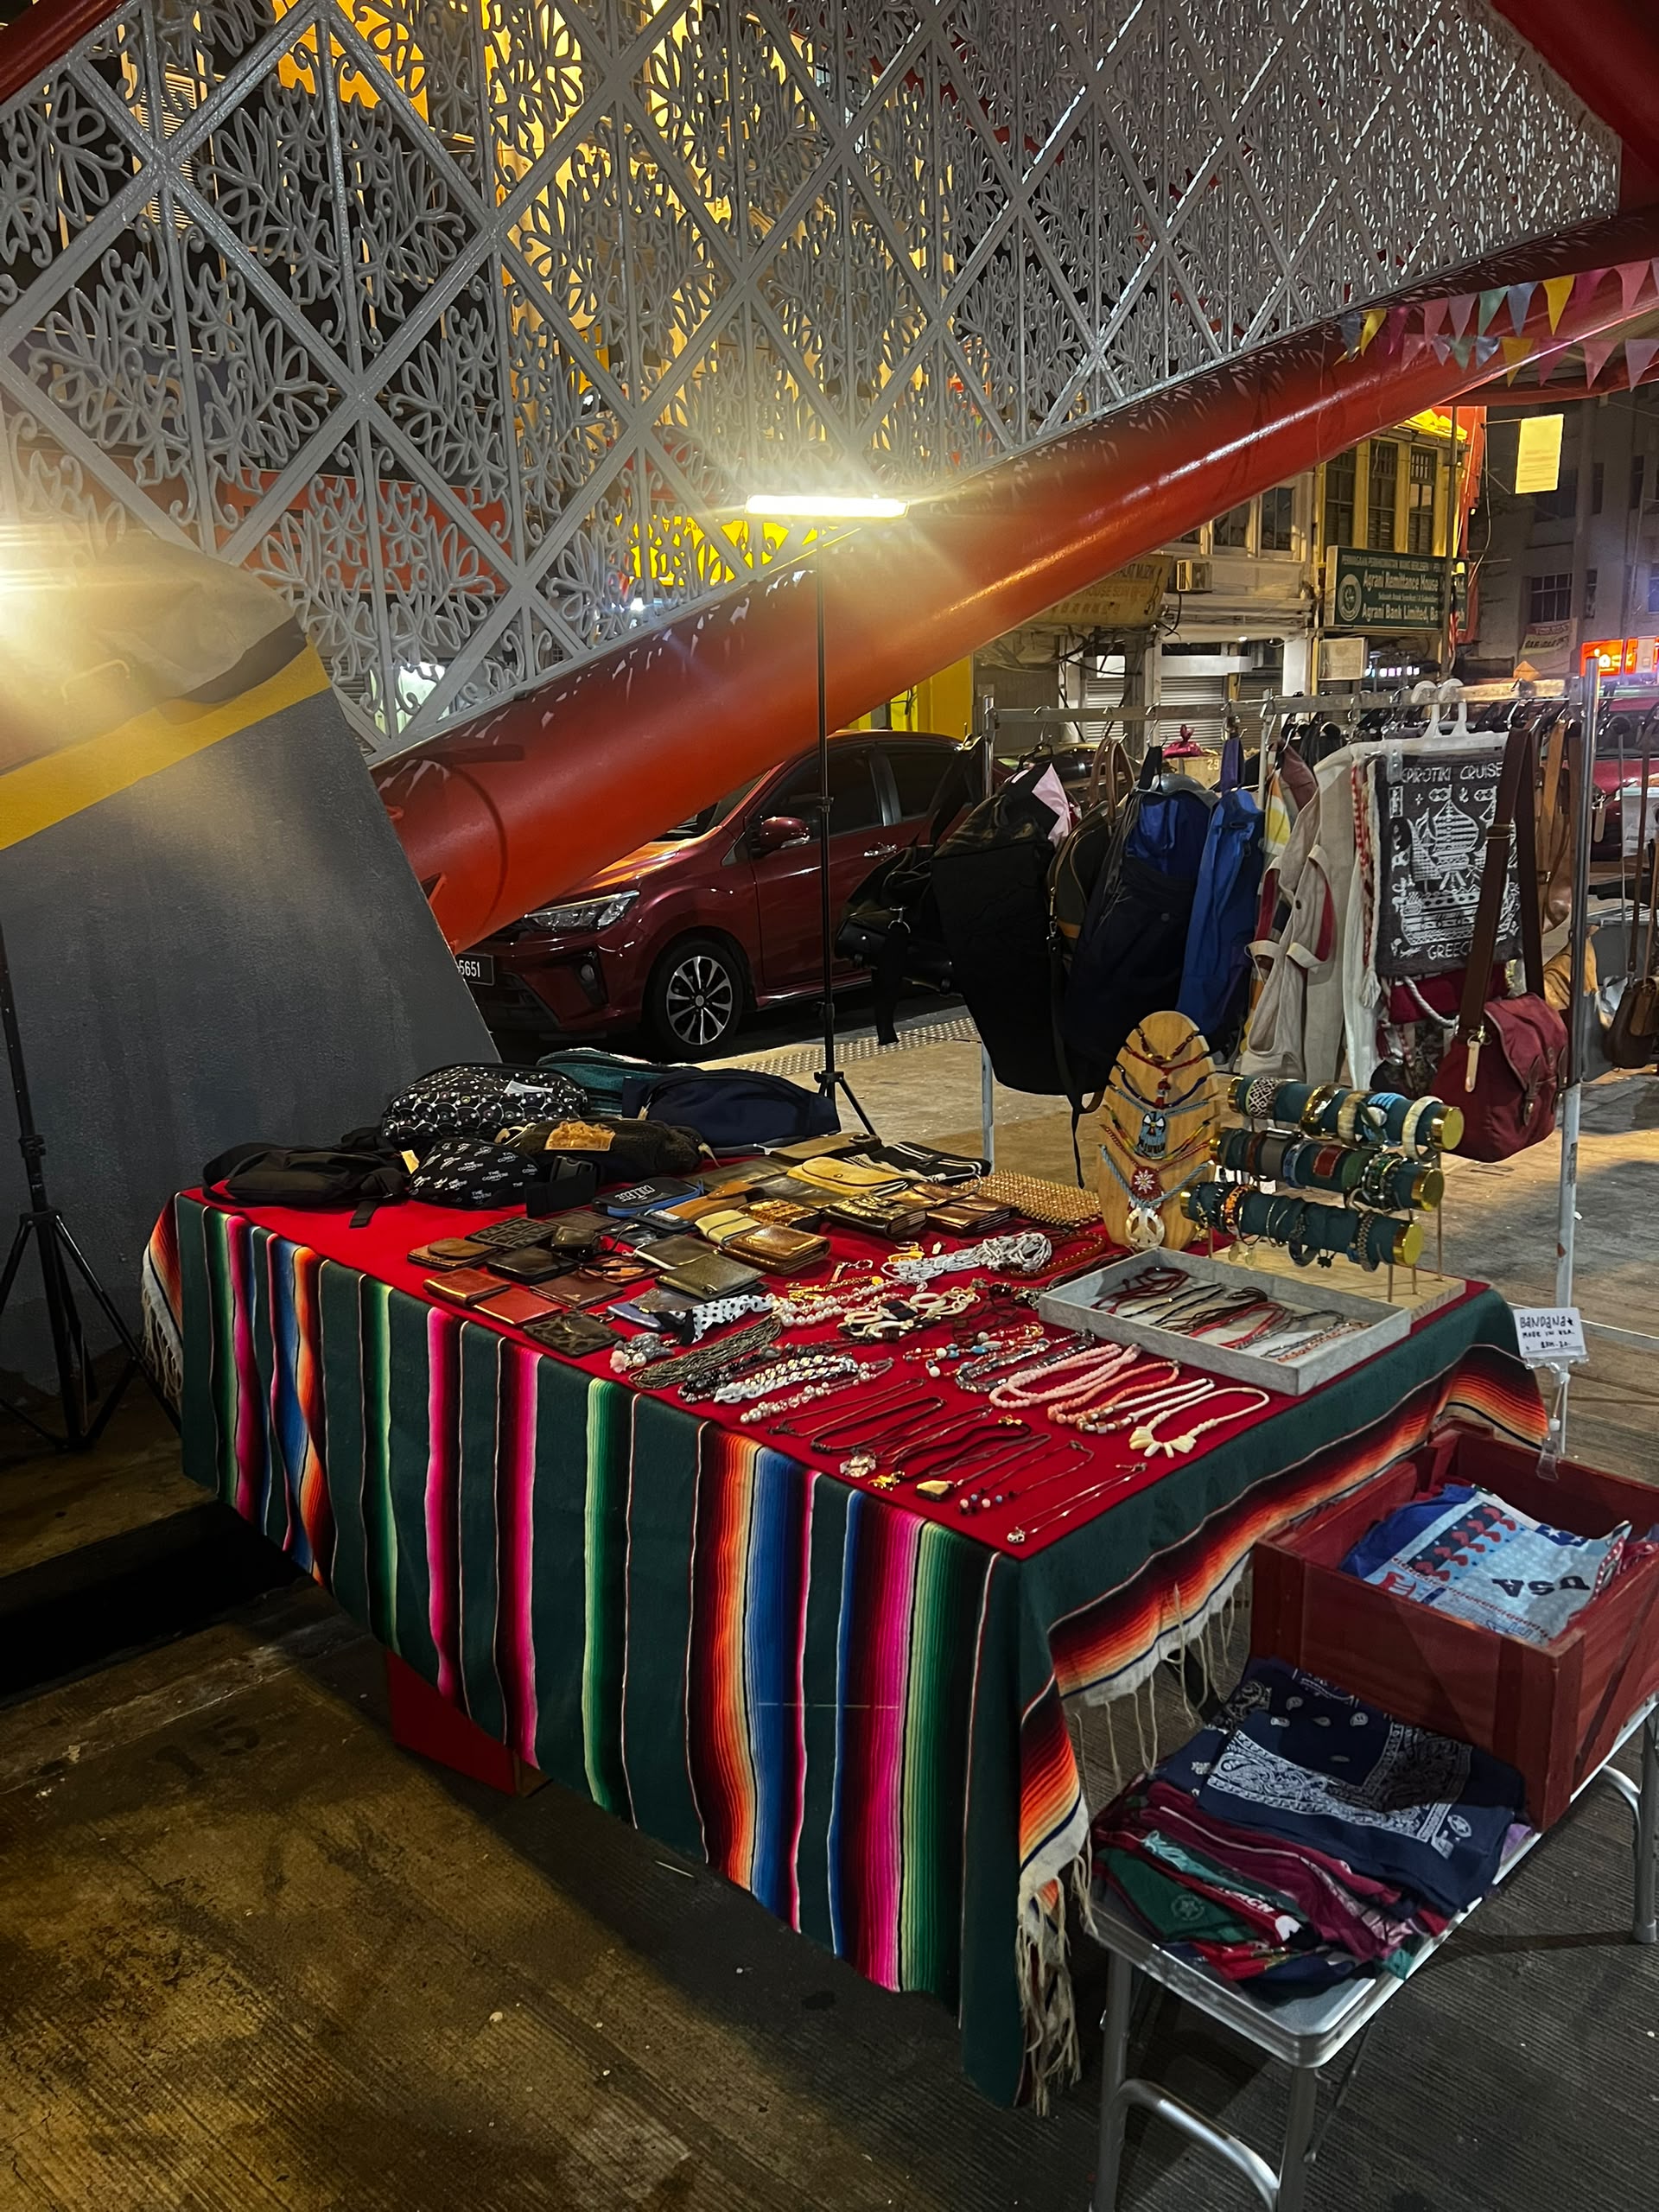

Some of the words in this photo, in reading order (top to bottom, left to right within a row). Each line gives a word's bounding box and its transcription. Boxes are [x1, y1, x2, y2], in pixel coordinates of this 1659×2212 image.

[1363, 569, 1384, 591] Agrani
[1385, 571, 1419, 589] Remittance
[1420, 574, 1439, 591] House
[1362, 603, 1384, 622] Agrani
[1385, 604, 1402, 620] Bank
[1427, 940, 1473, 961] GREEC
[1491, 1576, 1591, 1598] USA
